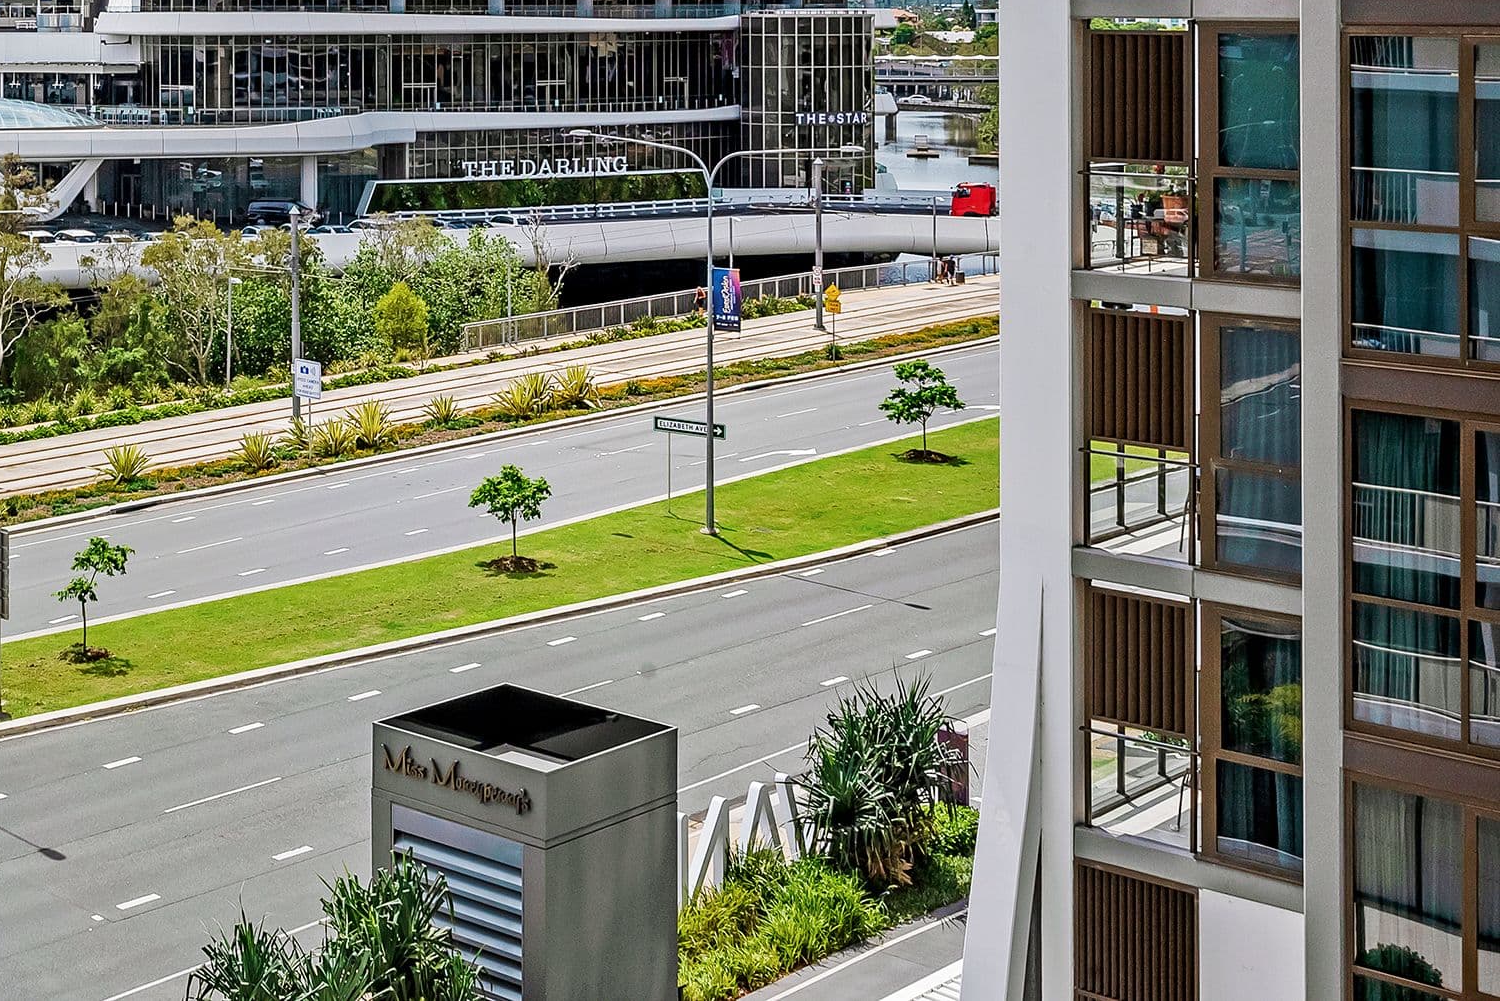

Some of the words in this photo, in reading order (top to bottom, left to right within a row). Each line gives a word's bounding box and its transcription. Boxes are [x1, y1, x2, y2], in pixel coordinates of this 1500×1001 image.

[795, 113, 827, 125] THE
[836, 112, 867, 124] STAR
[462, 160, 515, 179] THE
[519, 156, 629, 176] DARLING
[659, 420, 694, 431] ELIZABETH
[695, 425, 708, 433] AVE
[380, 743, 428, 779] Miss
